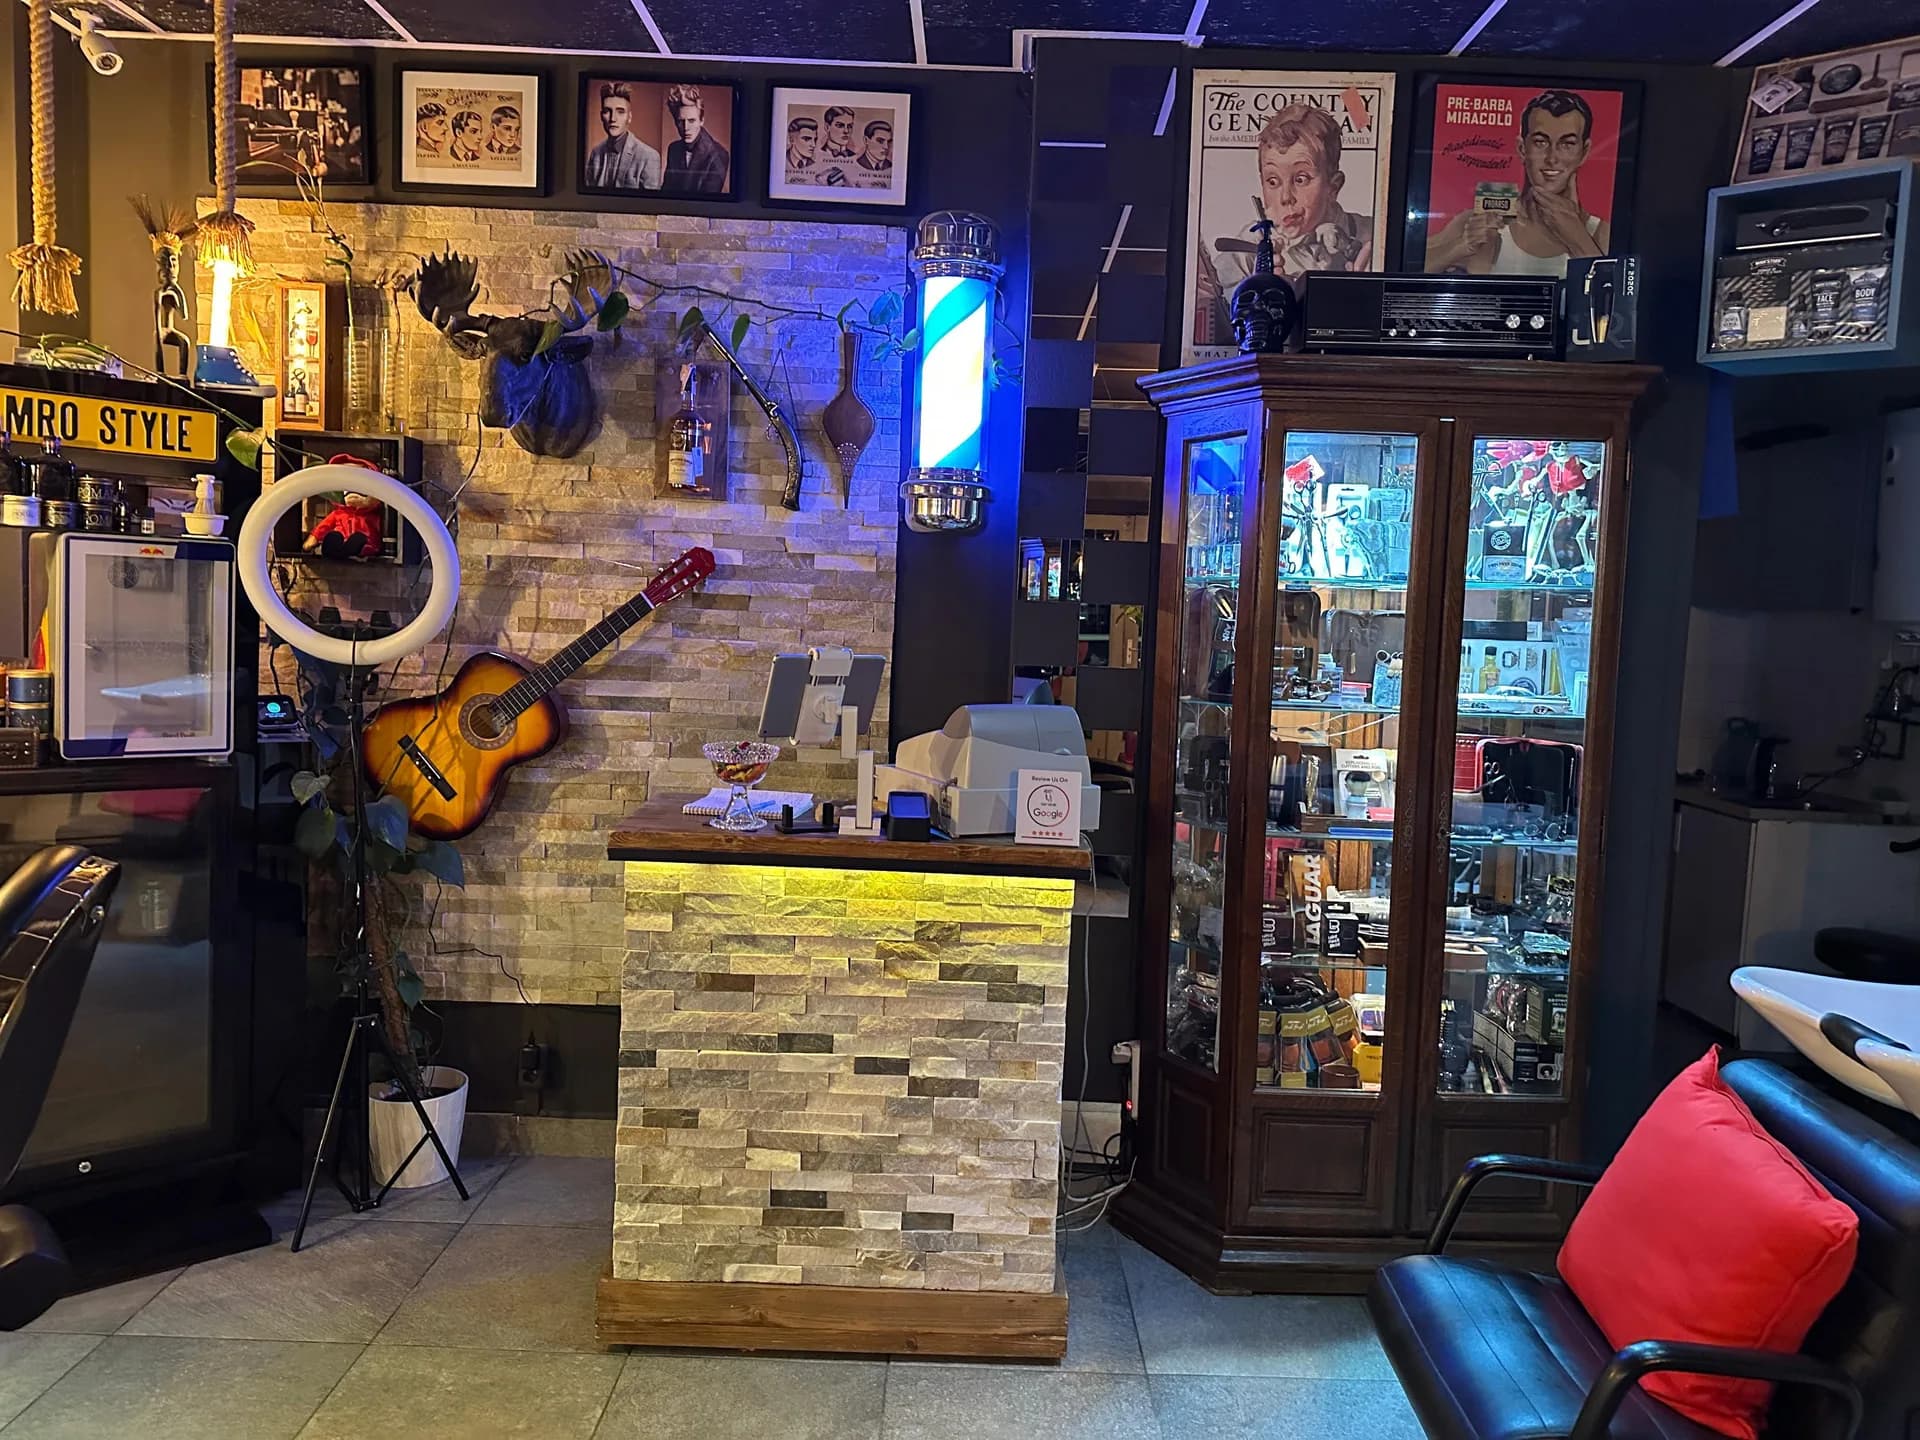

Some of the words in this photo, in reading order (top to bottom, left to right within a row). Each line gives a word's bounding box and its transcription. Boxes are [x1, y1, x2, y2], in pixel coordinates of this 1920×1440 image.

[1209, 91, 1246, 111] The
[1253, 93, 1375, 113] COUNTY
[1447, 96, 1513, 112] PRE-BARBA
[1446, 111, 1513, 127] MIRACOLO
[1342, 136, 1371, 145] FAMILY
[1627, 257, 1636, 268] FF
[1626, 270, 1636, 297] 2020C
[1817, 294, 1834, 303] FACE
[1855, 287, 1877, 299] BODY
[1193, 350, 1230, 359] WHAT
[5, 394, 79, 441] MRO
[99, 405, 193, 453] STYLE
[1033, 807, 1064, 820] Google
